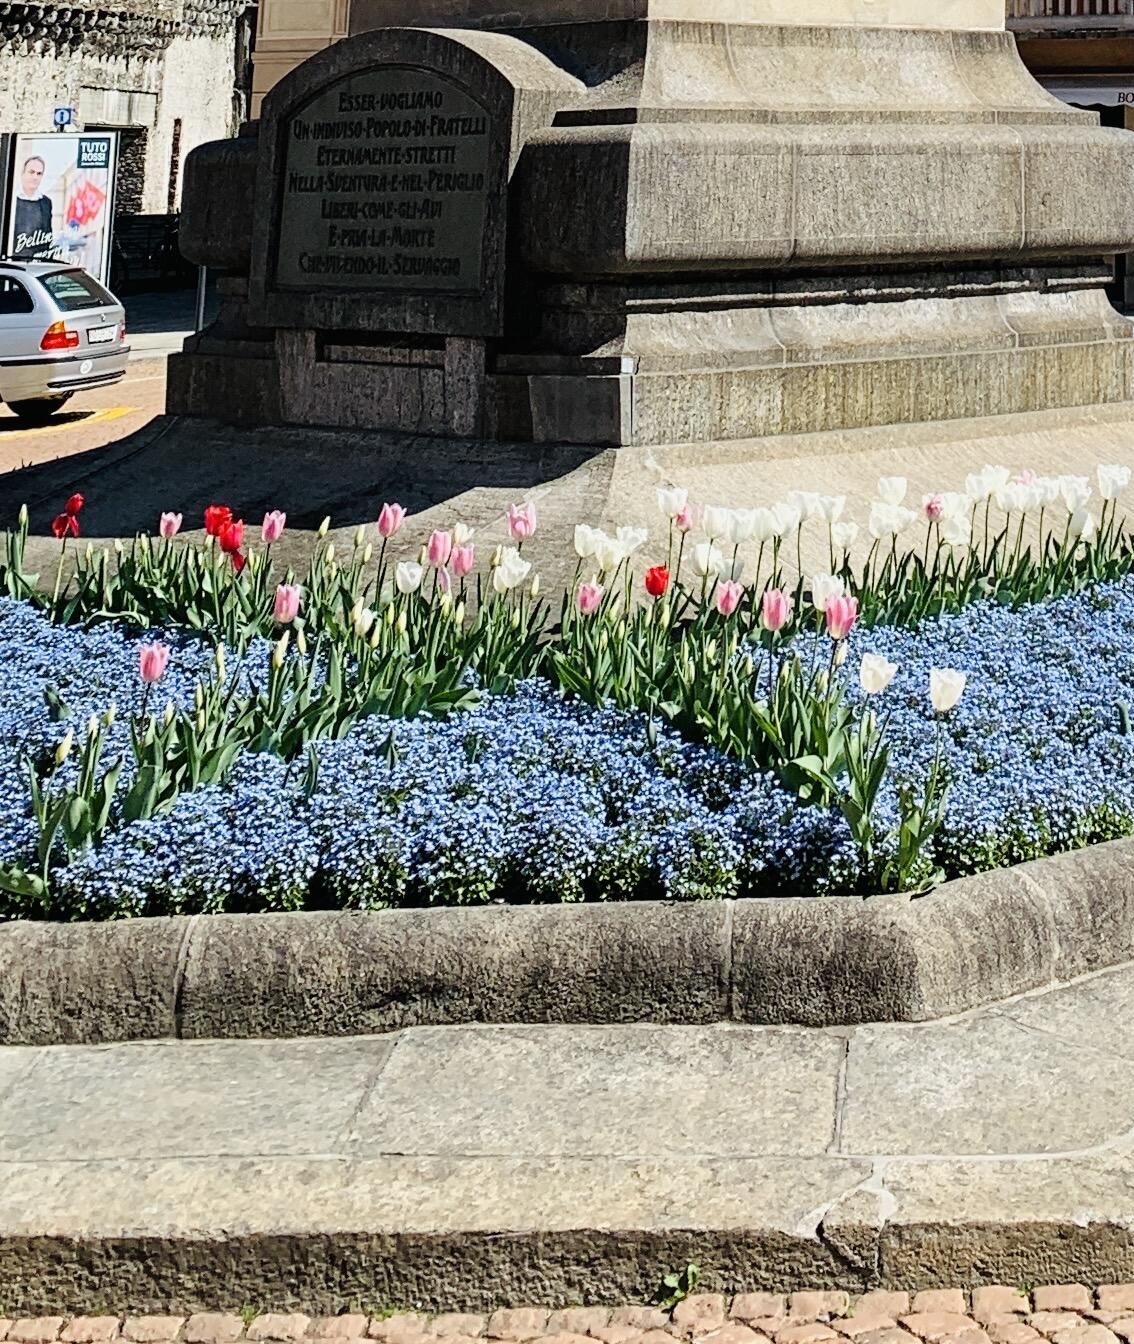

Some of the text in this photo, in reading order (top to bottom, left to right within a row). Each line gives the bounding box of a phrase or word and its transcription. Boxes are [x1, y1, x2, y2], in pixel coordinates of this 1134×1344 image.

[337, 92, 375, 112] ESSER
[366, 117, 411, 138] POPOLO
[430, 115, 486, 137] FRATELLI
[80, 141, 108, 153] TUTO
[405, 146, 456, 165] STRETTI
[81, 152, 106, 162] ROSSI
